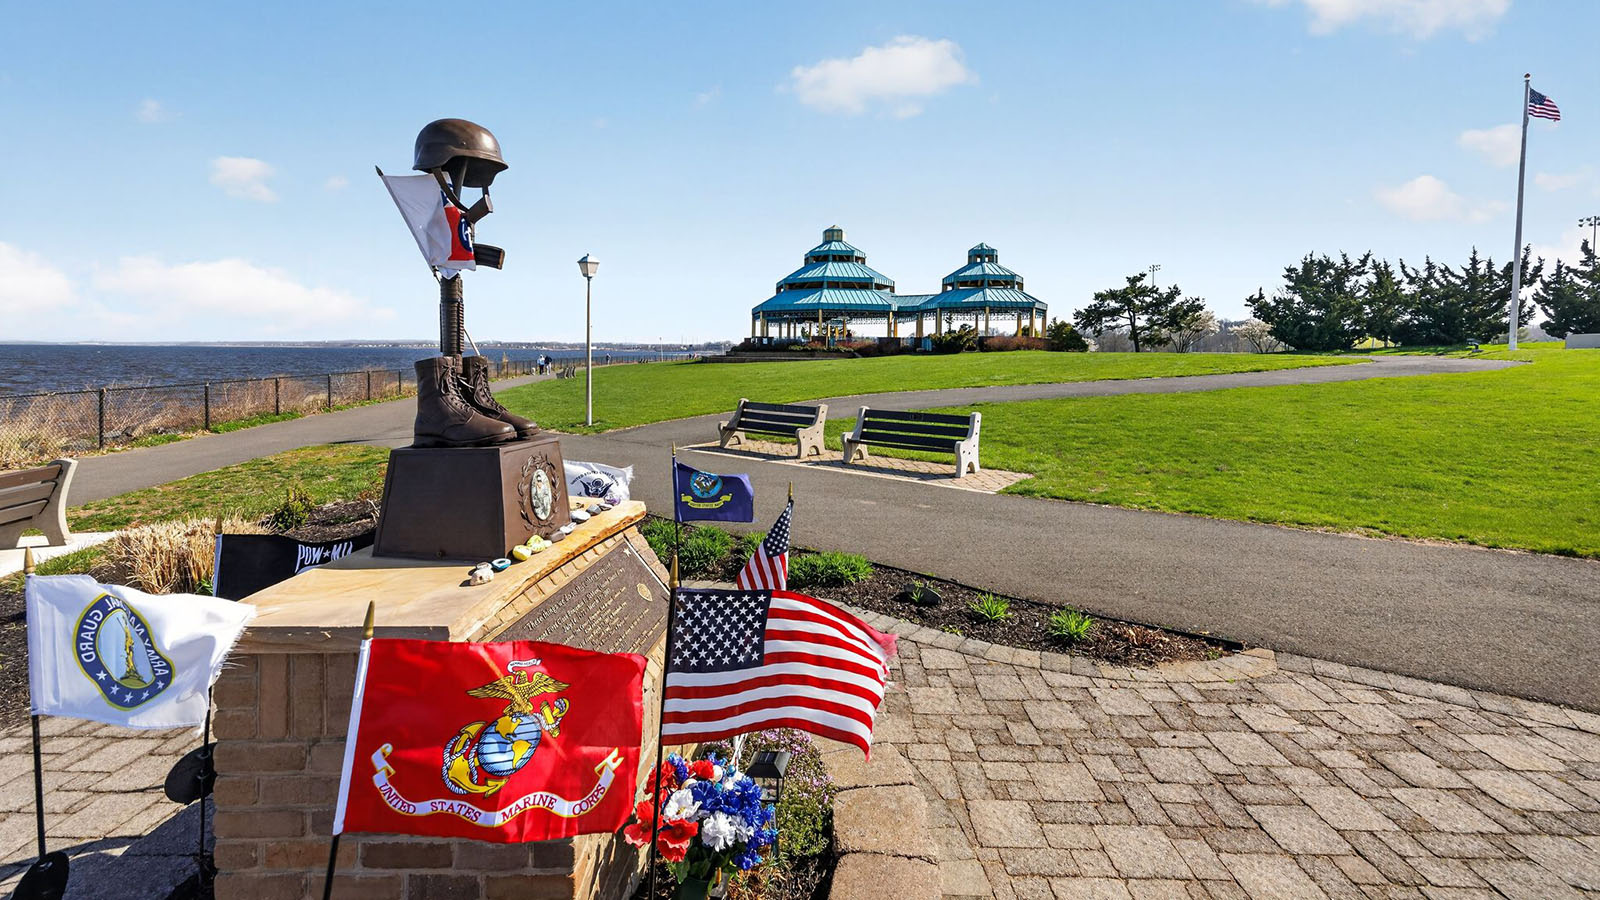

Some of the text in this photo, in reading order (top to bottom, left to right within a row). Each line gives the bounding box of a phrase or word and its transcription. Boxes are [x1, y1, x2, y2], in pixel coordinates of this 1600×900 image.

[295, 544, 324, 573] POW
[379, 782, 606, 823] UNITED STATES MARINE CORPS
